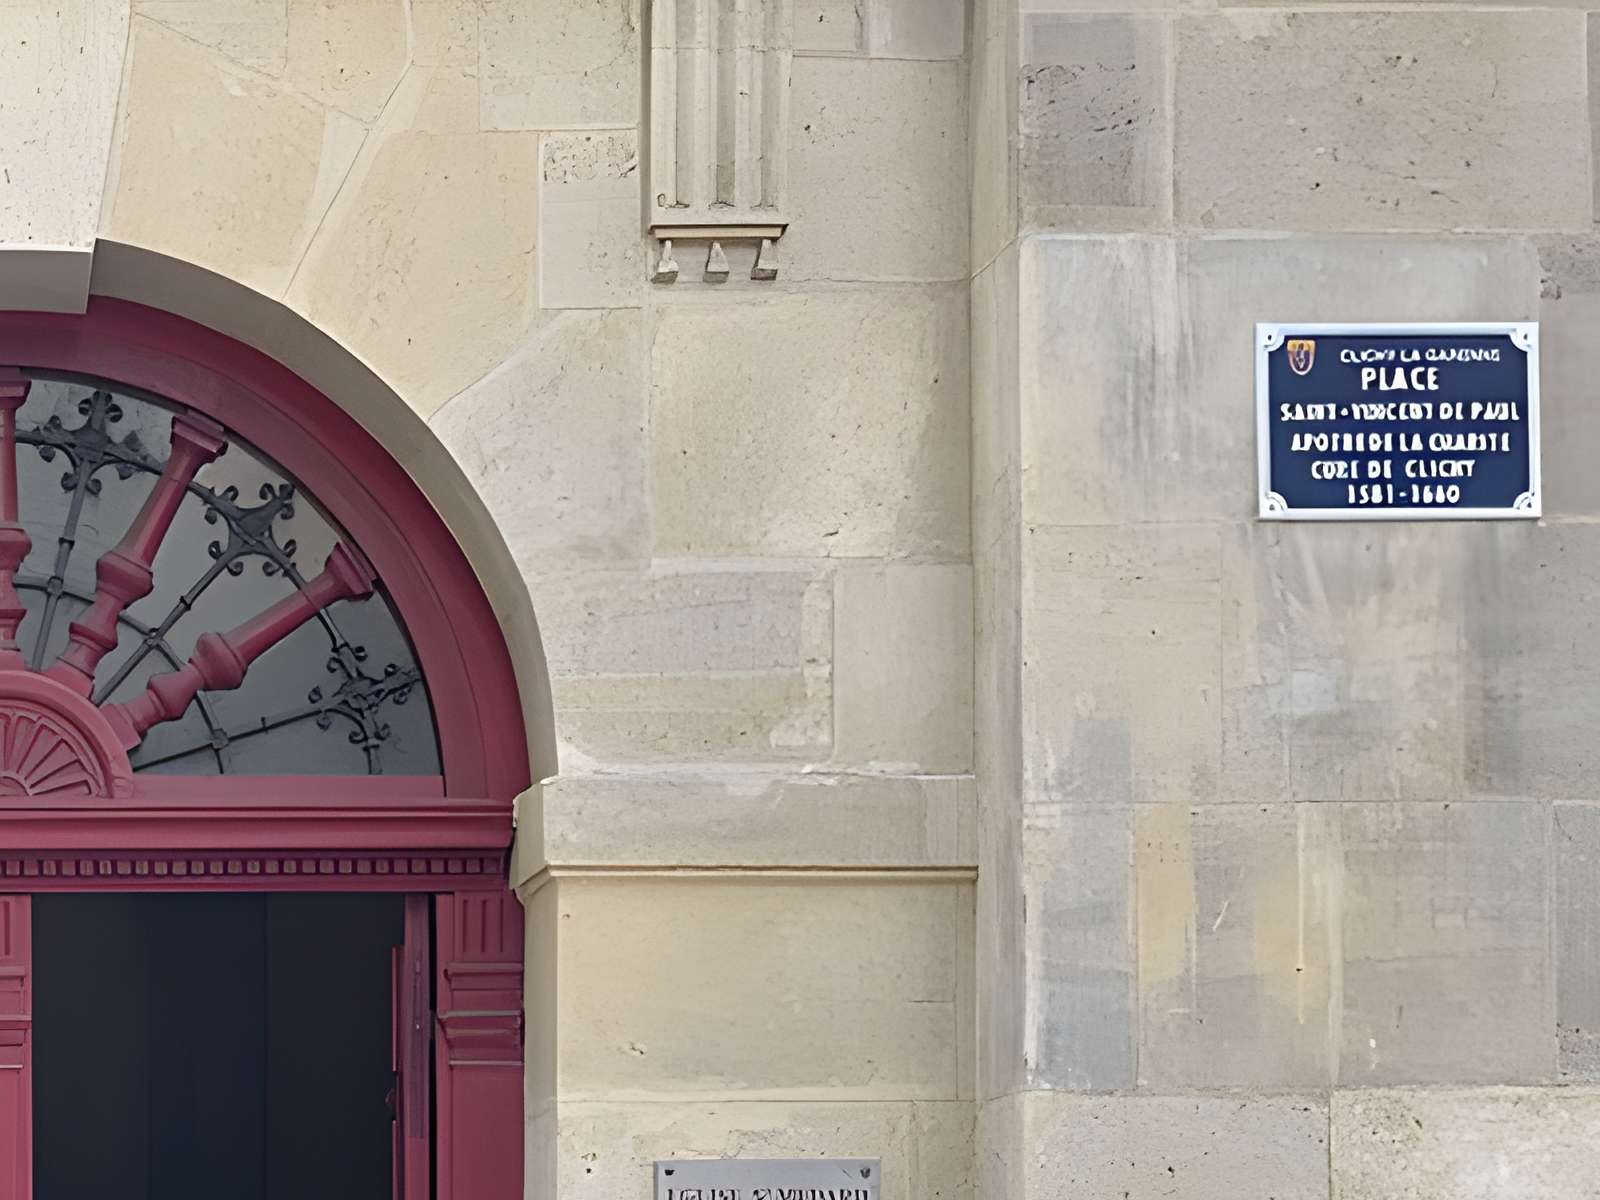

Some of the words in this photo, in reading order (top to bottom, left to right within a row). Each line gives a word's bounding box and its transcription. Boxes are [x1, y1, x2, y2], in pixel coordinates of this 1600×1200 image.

[1361, 366, 1440, 391] PLACE
[1439, 402, 1464, 421] DE
[1470, 401, 1520, 421] PAUL
[1368, 432, 1393, 452] DE
[1399, 432, 1424, 452] LA
[1367, 459, 1392, 479] DE
